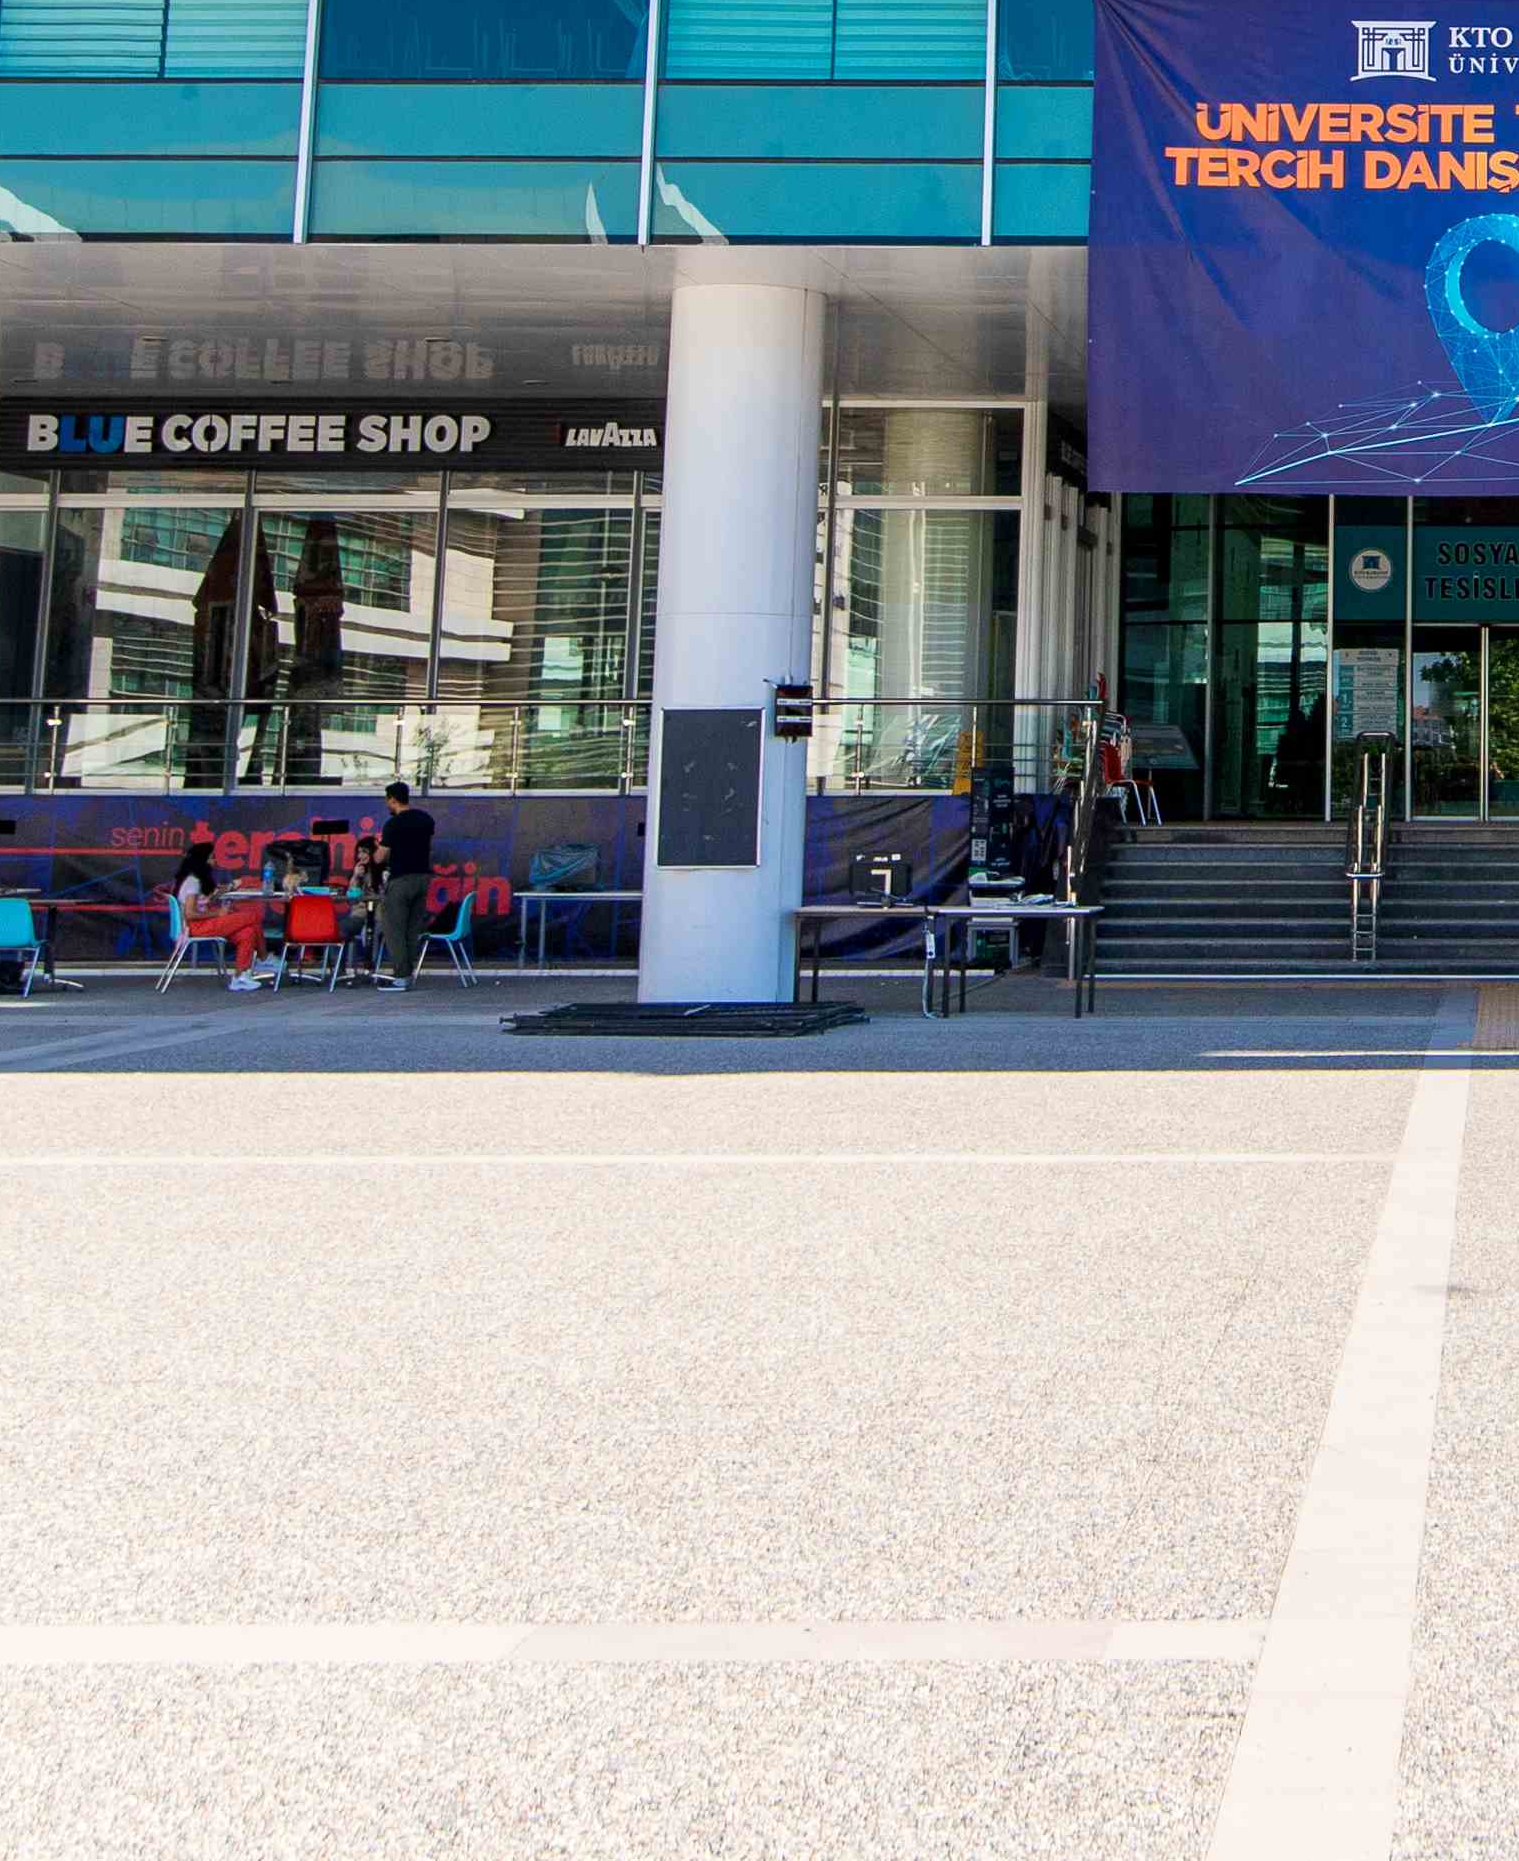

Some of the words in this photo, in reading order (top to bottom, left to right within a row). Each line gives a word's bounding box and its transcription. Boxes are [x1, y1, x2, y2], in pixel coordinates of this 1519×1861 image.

[1448, 26, 1513, 48] KTO
[1164, 147, 1345, 189] TERCİH
[27, 414, 155, 453] BLUE
[161, 414, 347, 453] COFFEE
[356, 414, 491, 453] SHOP
[564, 422, 658, 448] LAVAZZA
[111, 820, 185, 849] senin
